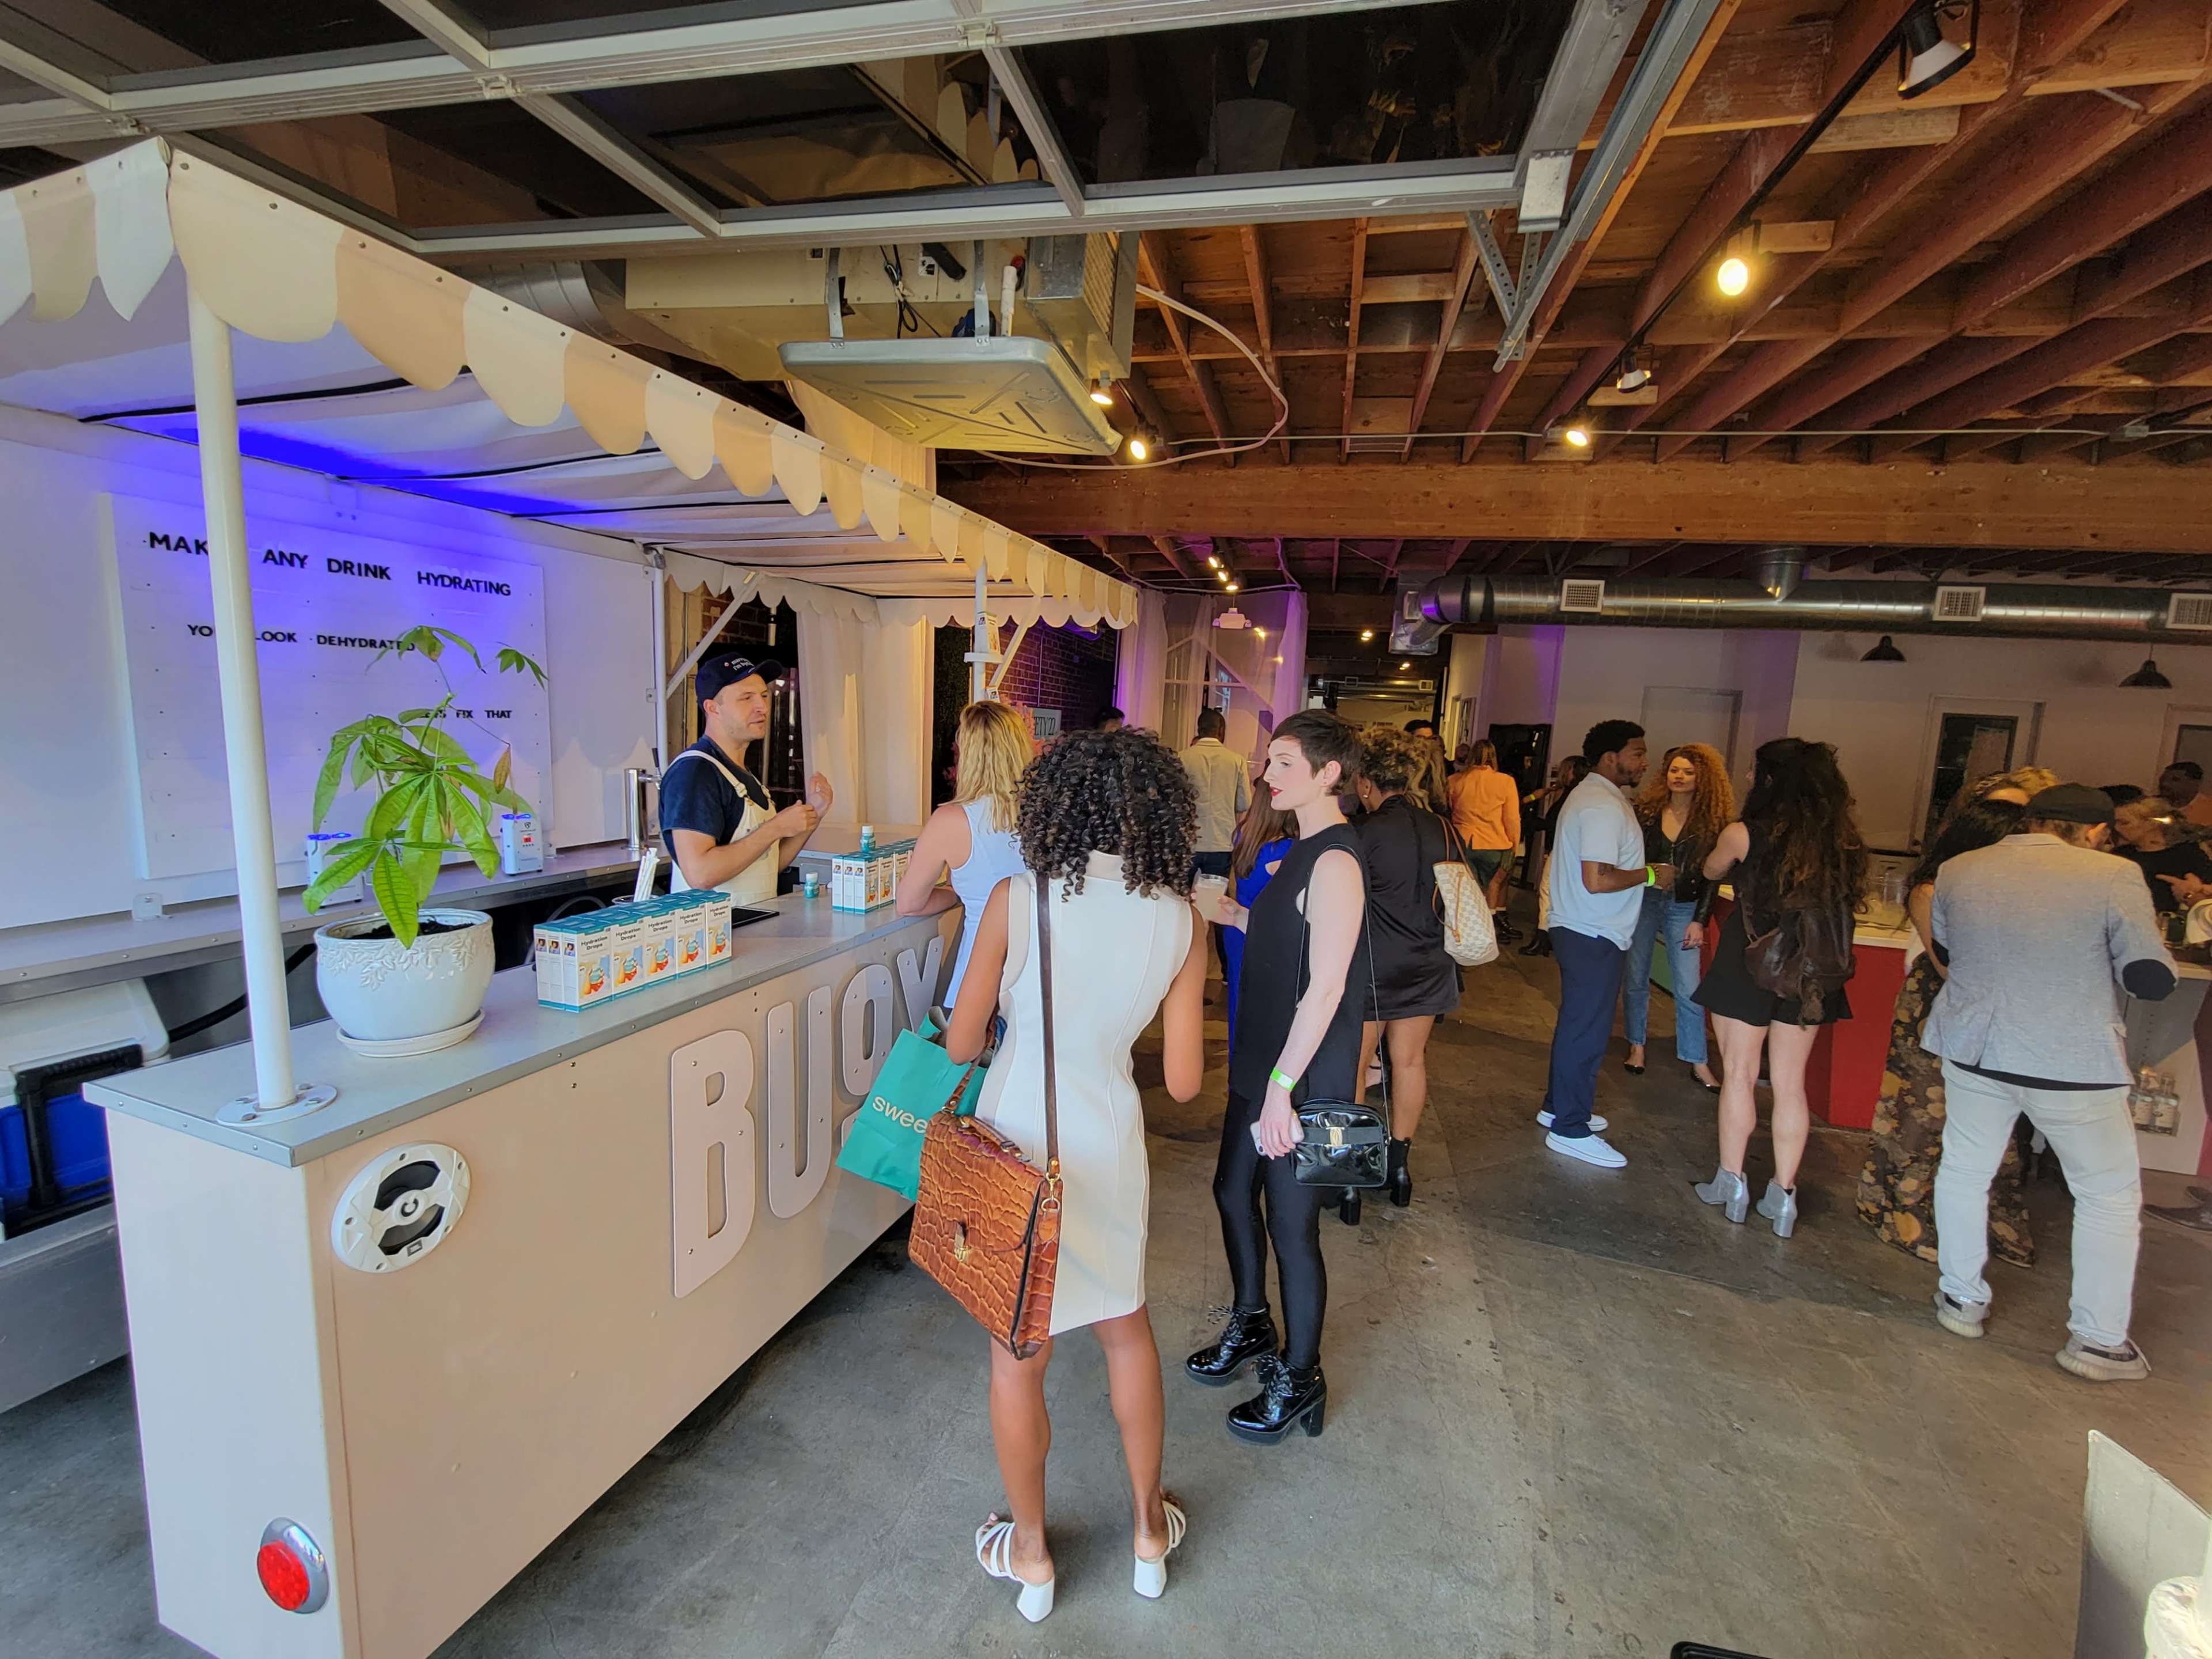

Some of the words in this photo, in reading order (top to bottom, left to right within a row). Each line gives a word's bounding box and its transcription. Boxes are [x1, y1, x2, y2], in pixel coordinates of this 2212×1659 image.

[149, 531, 209, 556] MAK
[262, 549, 309, 569] ANY
[327, 558, 392, 581] DRINK
[417, 570, 512, 596] HYDRATING
[187, 624, 214, 637] YO
[255, 631, 298, 643] OOK
[456, 710, 474, 719] FIX
[484, 710, 512, 719] THAT
[648, 919, 673, 928] Hydration
[615, 927, 641, 937] Hydration
[581, 936, 608, 946] Hydration
[872, 1096, 928, 1134] swee
